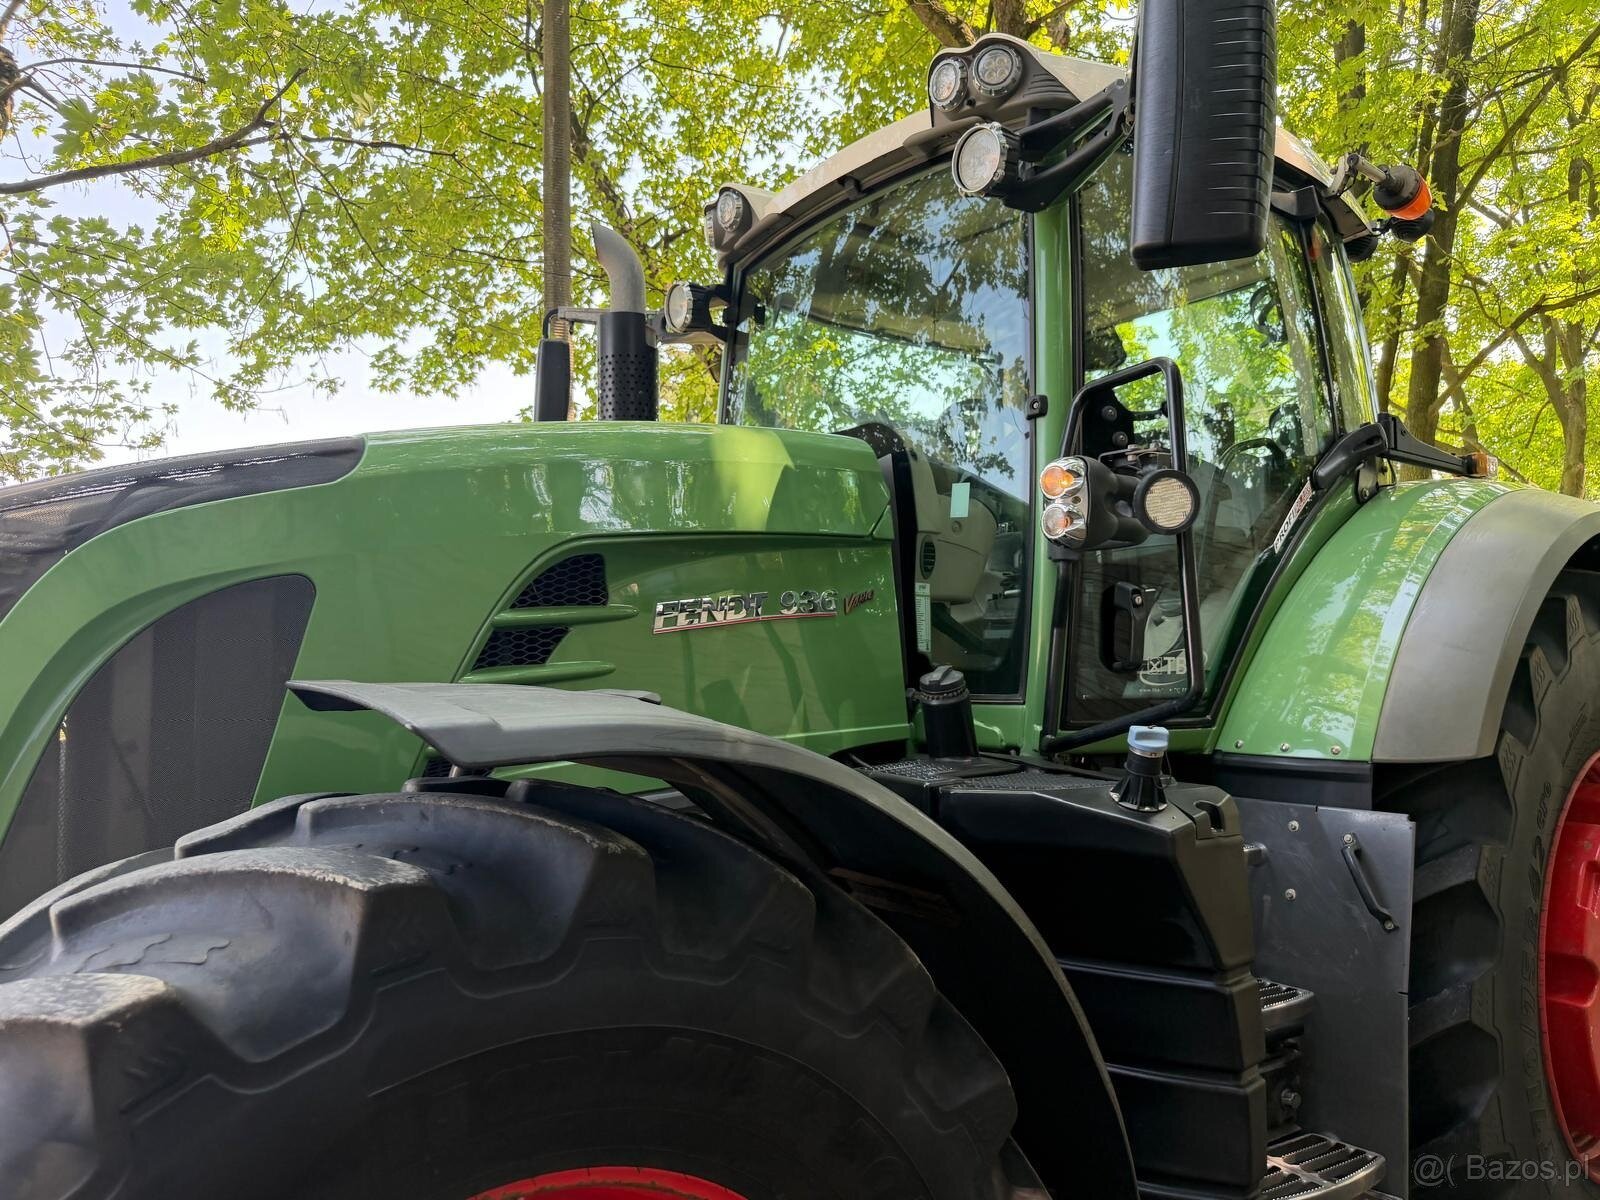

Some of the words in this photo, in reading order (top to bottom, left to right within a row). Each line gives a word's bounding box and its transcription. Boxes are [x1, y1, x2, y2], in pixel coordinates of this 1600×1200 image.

[1274, 508, 1297, 550] PROFI
[653, 591, 768, 630] FENDT
[780, 589, 838, 615] 936
